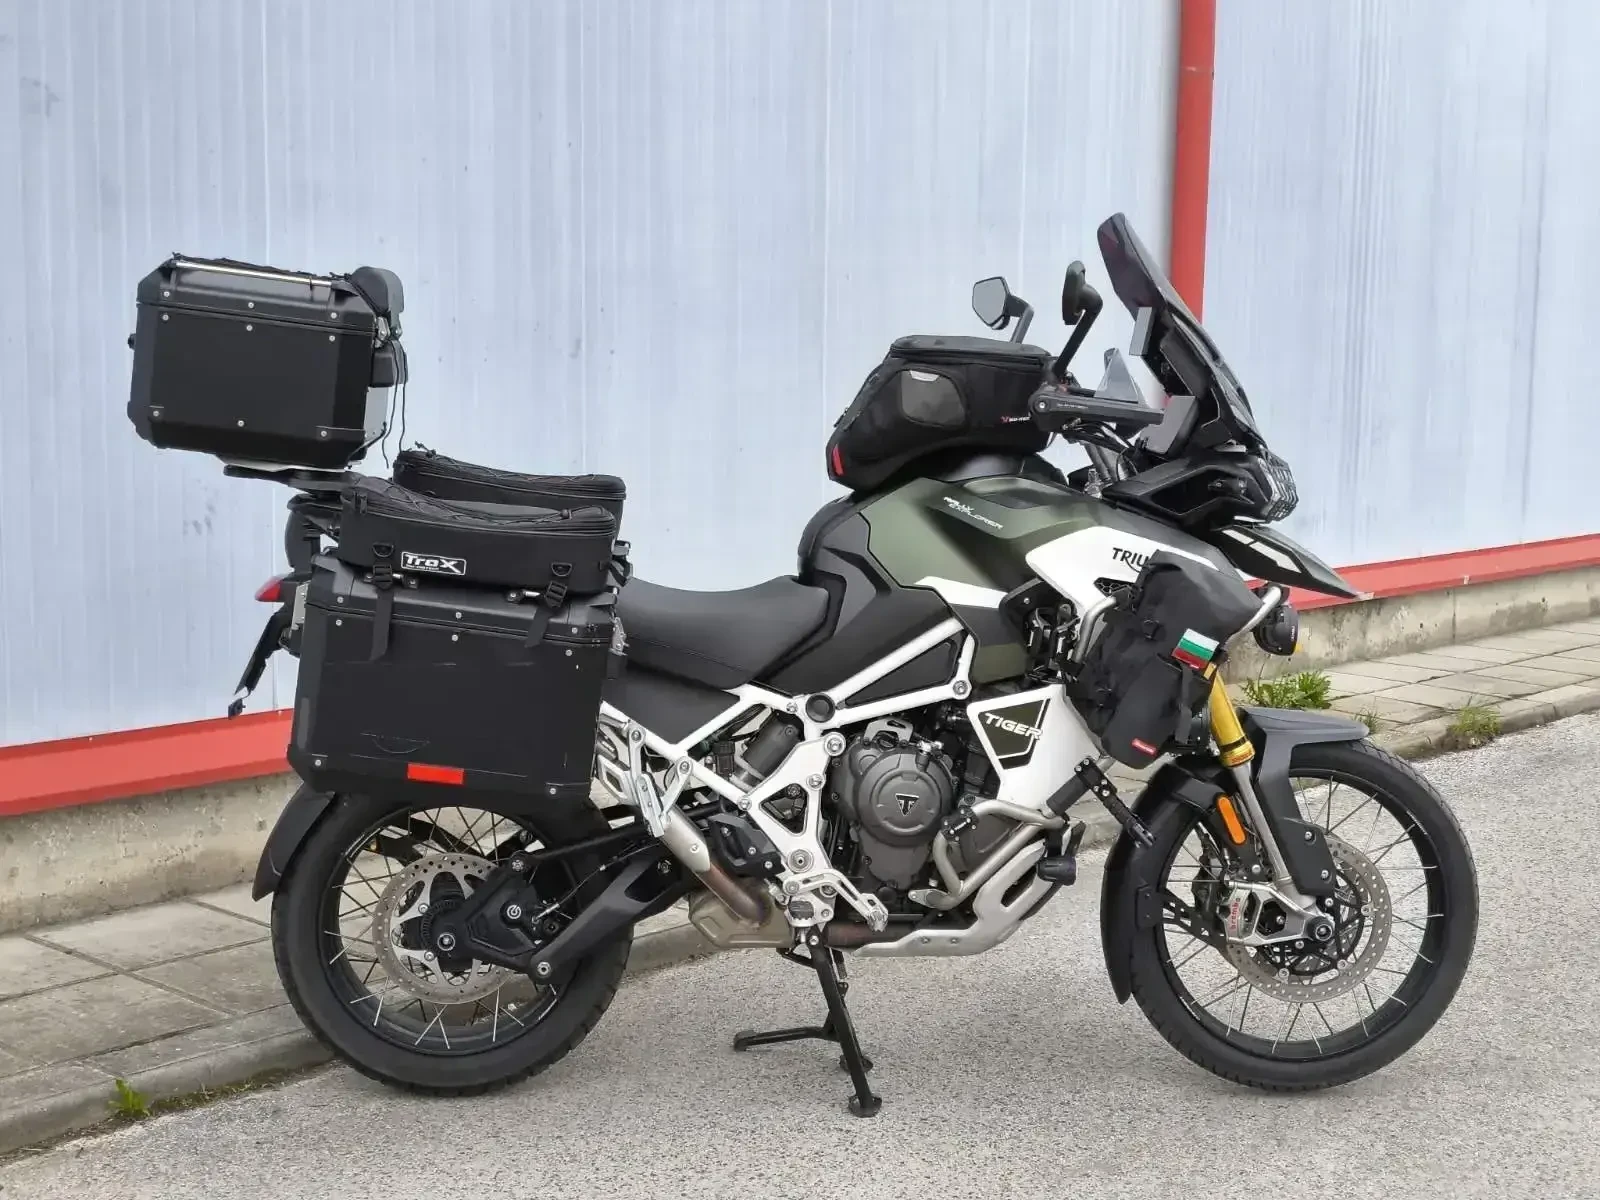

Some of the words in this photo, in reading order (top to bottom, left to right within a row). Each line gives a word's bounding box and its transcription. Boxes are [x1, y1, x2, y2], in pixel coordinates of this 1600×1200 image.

[1112, 547, 1149, 574] TRIU
[984, 712, 1043, 741] TIGER
[1231, 897, 1241, 930] brembo
